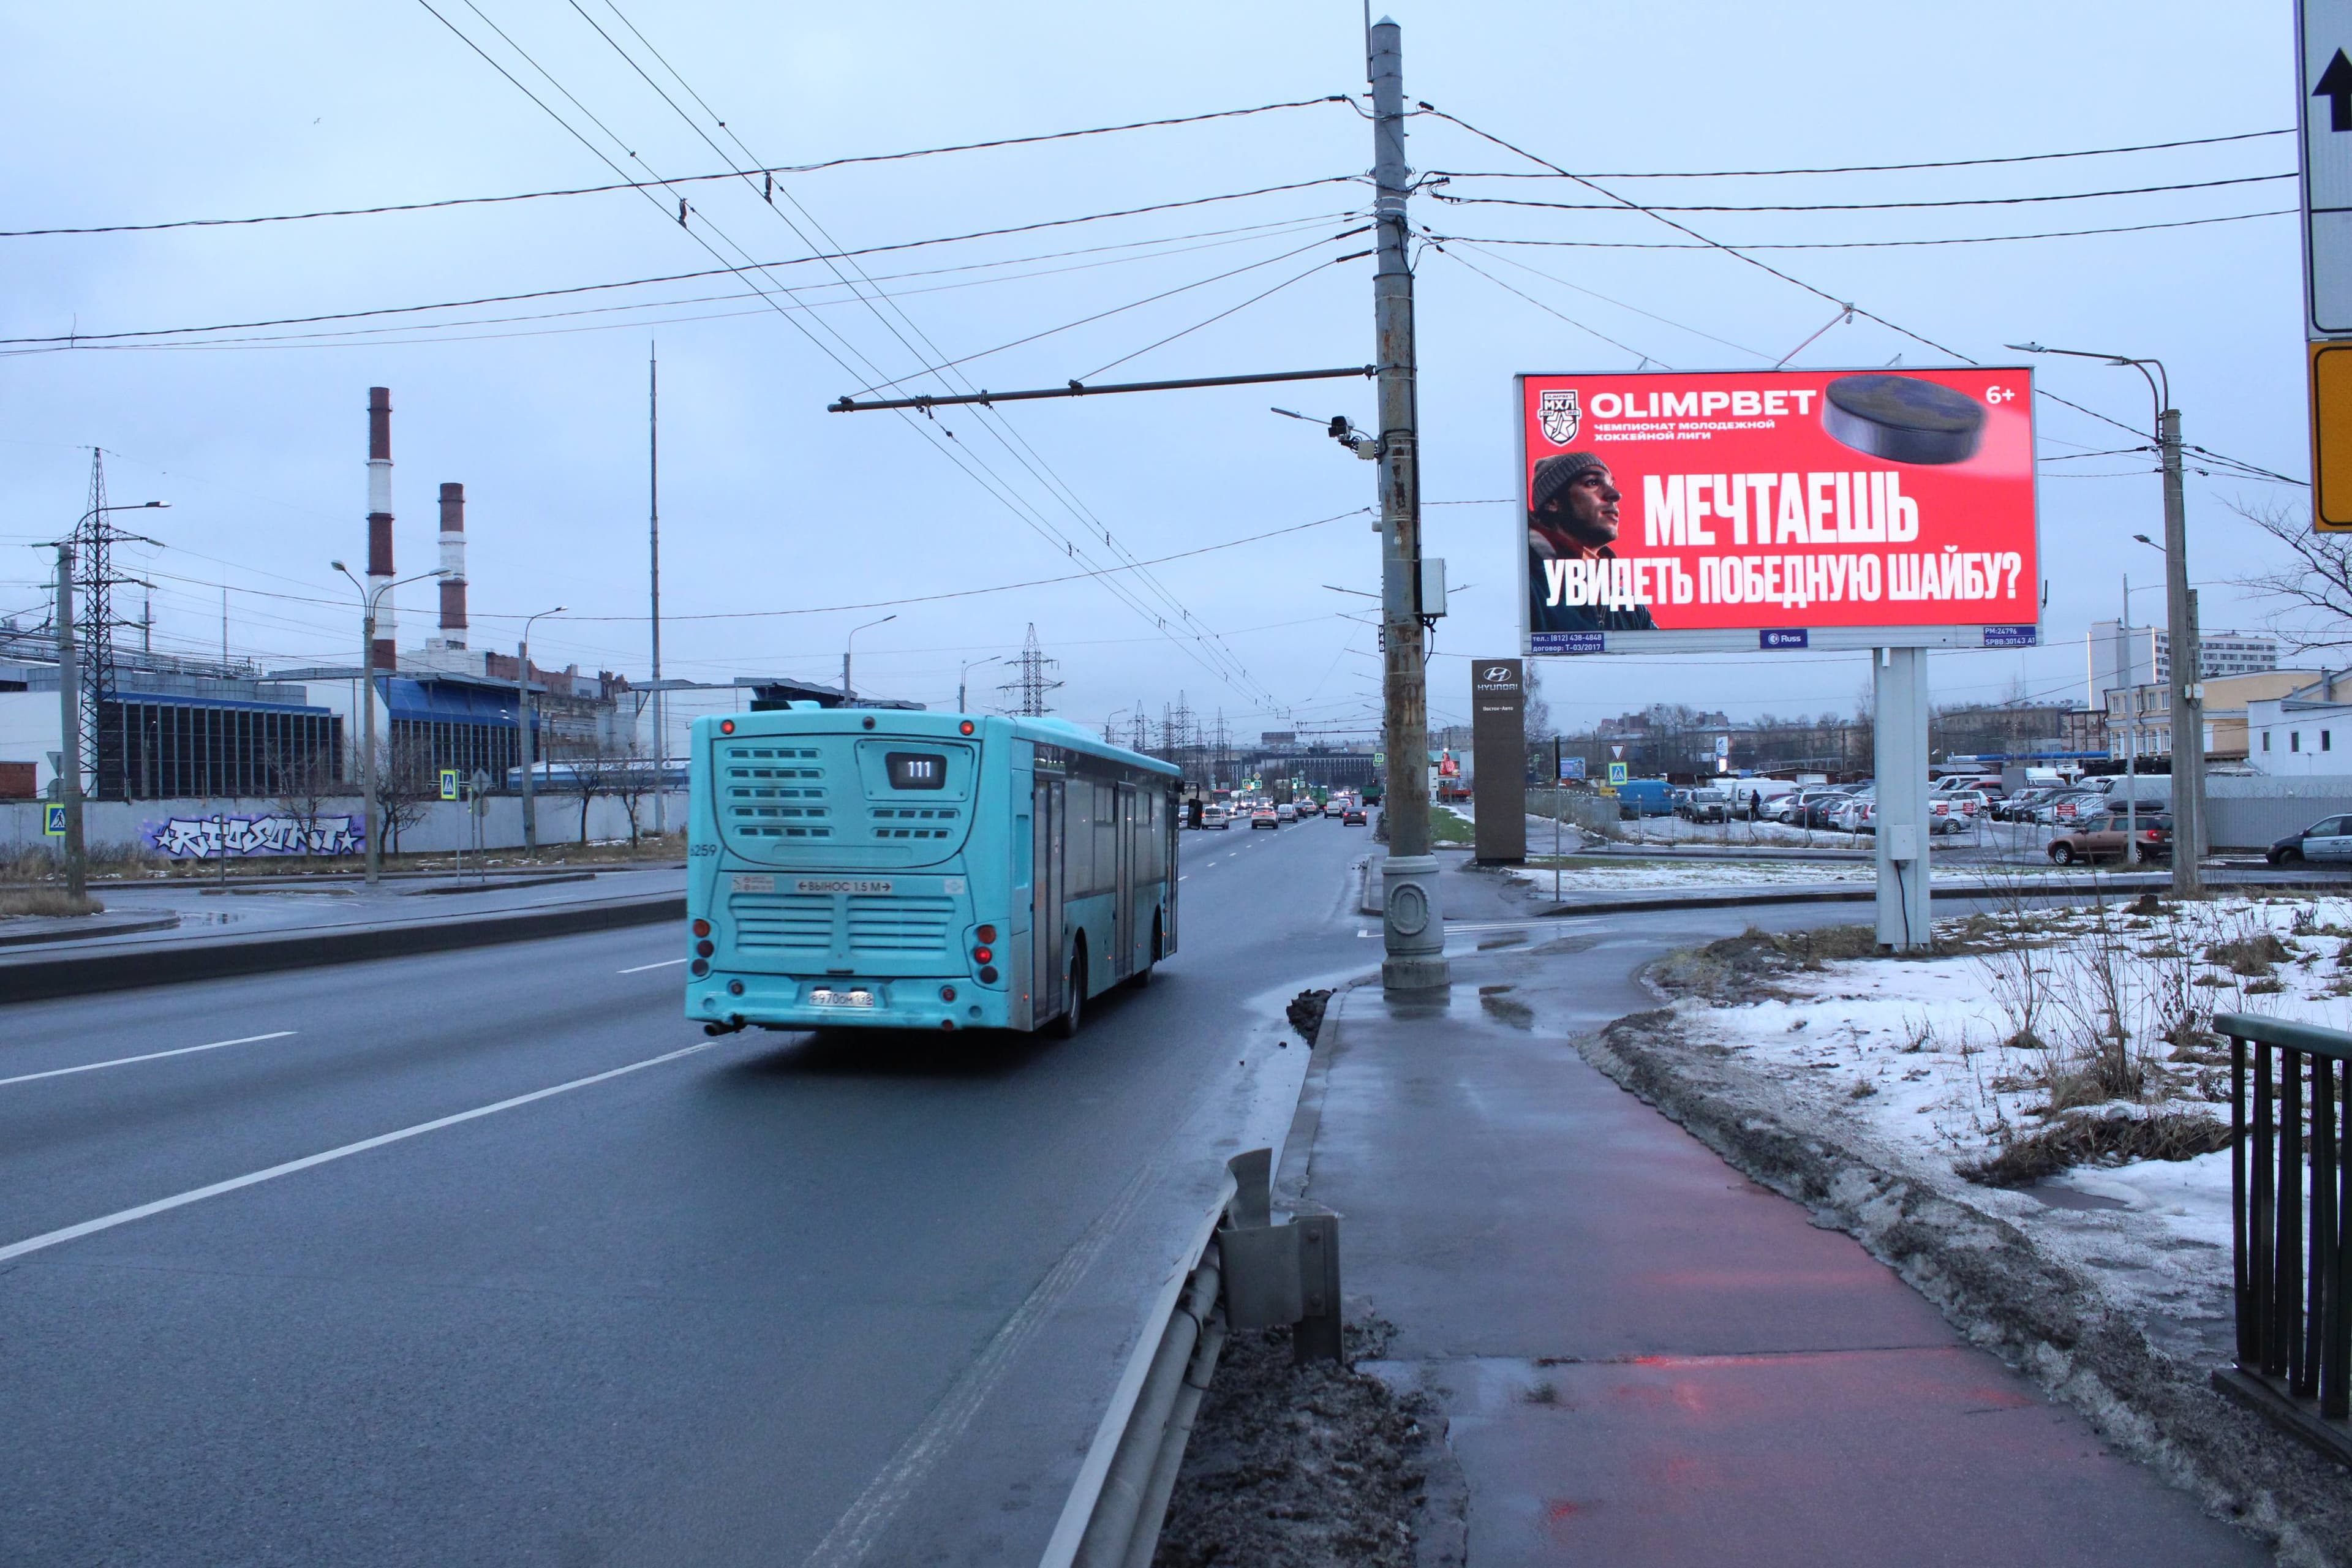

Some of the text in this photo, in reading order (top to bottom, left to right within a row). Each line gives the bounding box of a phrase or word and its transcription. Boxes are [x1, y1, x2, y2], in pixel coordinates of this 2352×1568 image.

[1986, 385, 2015, 404] 6+
[1544, 400, 1575, 410] МХЛ
[1590, 390, 1817, 418] OLIMPBET
[1594, 420, 1775, 431] ЧЕМПИОНАТ МОЛОДЕЖНОЙ
[1594, 431, 1675, 441] ХОККЕЙНОЙ
[1643, 471, 1920, 546] МЕЧТАЕШЬ
[1543, 545, 2022, 612] УВИДЕТЬ ПОБЕДНУЮ ШАЙБУ?
[908, 761, 930, 777] 111
[809, 882, 850, 891] ВЫНОС
